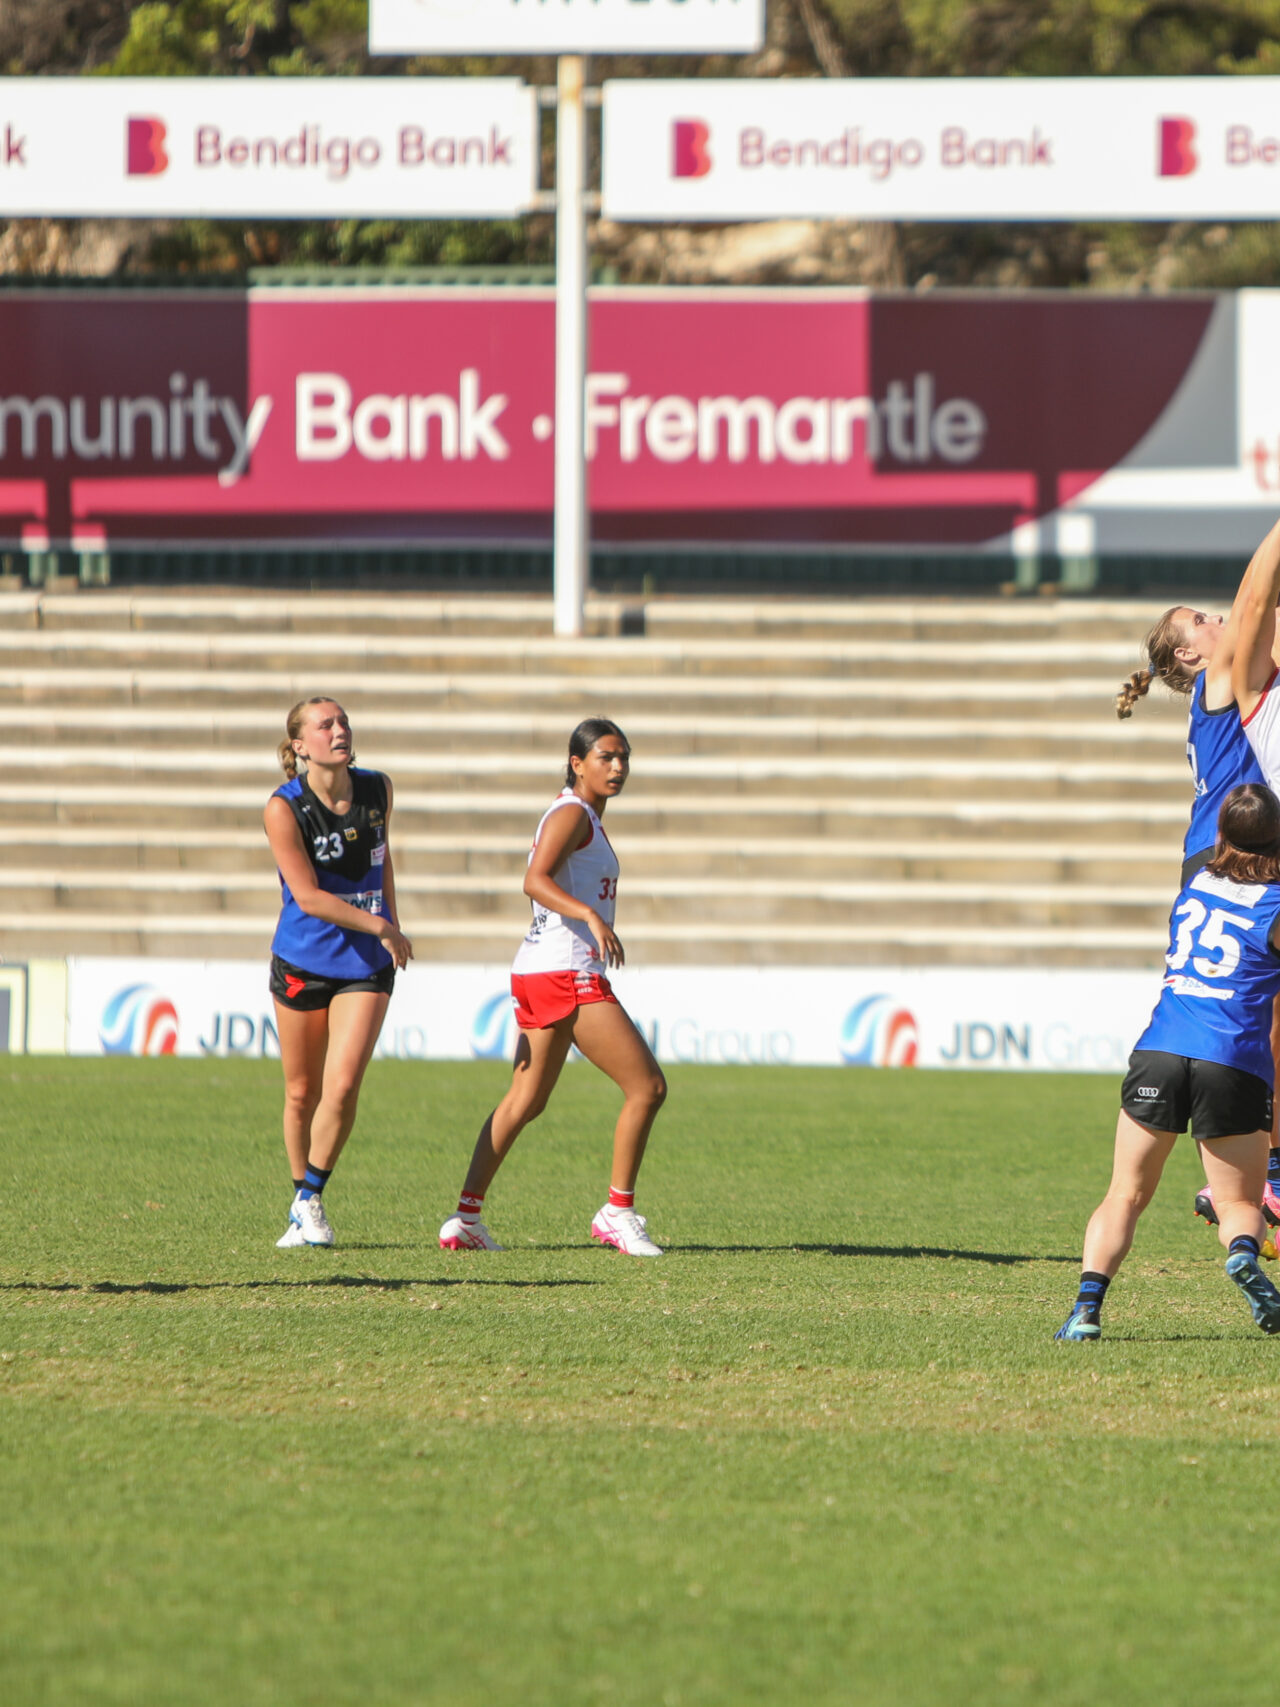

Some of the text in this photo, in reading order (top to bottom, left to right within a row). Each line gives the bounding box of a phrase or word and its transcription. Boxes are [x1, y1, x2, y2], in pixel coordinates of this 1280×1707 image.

[195, 124, 381, 180] Bendigo
[399, 124, 513, 167] Bank
[738, 126, 925, 183] Bendigo
[940, 126, 1054, 168] Bank
[295, 368, 509, 461] Bank
[584, 372, 988, 464] Fremantle
[314, 832, 345, 861] 23
[1165, 898, 1256, 978] 35
[671, 1018, 796, 1064] Group
[940, 1022, 1031, 1061] JDN
